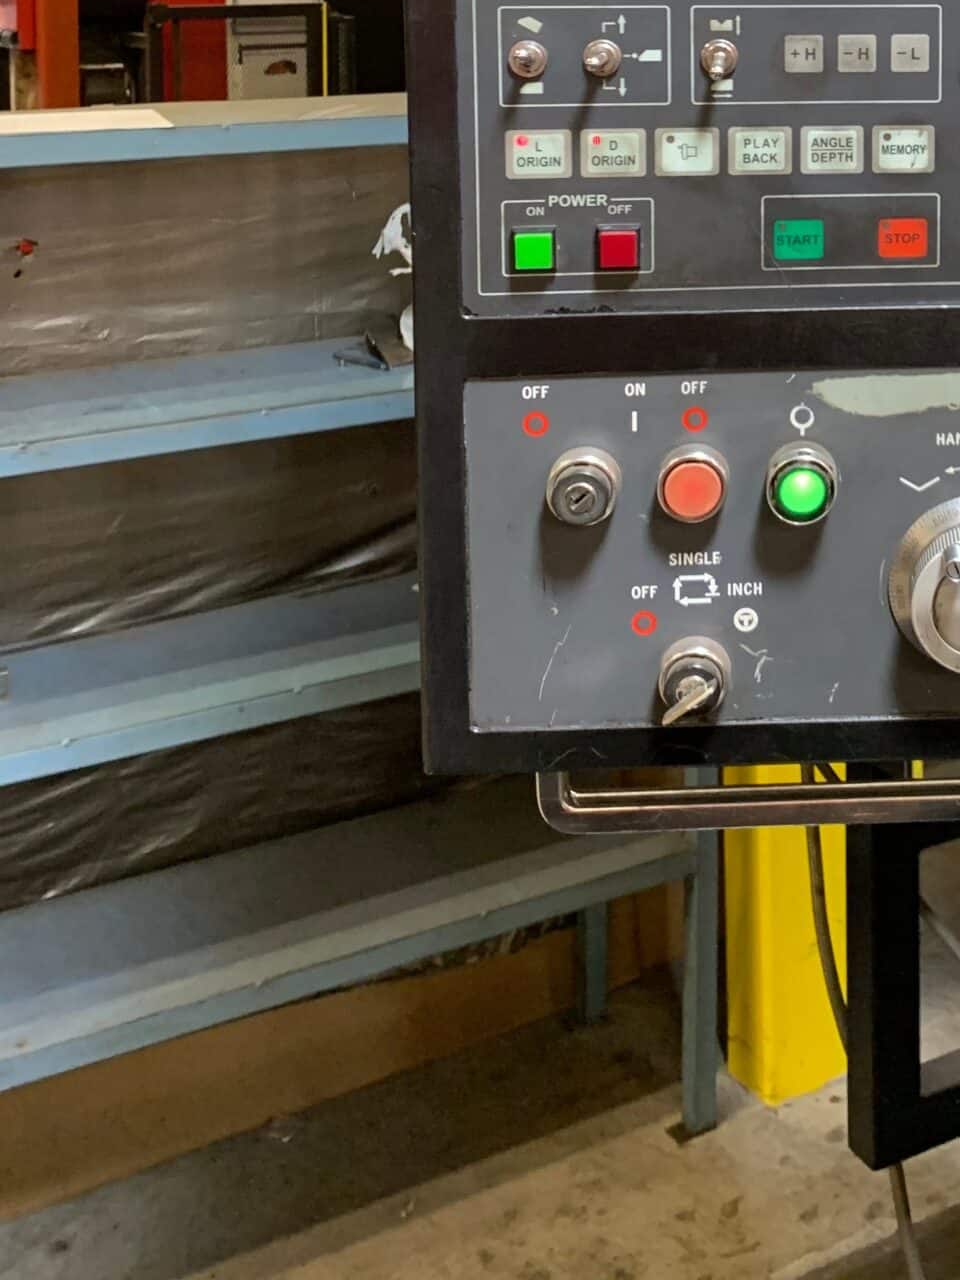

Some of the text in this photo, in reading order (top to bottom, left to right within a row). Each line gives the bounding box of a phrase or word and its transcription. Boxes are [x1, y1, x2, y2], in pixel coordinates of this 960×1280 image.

[535, 141, 542, 152] L
[609, 140, 618, 151] D
[743, 138, 779, 149] PLAY
[811, 137, 853, 148] ANGLE
[881, 144, 927, 155] MEMORY
[516, 156, 561, 168] ORIGIN
[591, 155, 636, 166] ORIGIN
[743, 153, 778, 164] BACK
[811, 152, 853, 163] DEPTH
[548, 194, 608, 207] POWER
[526, 206, 545, 216] ON
[608, 204, 632, 215] OFF
[776, 234, 820, 245] START
[885, 233, 921, 244] STOP
[521, 386, 550, 399] OFF
[624, 382, 646, 396] ON
[681, 381, 708, 394] OFF
[669, 552, 721, 566] SINGLE
[631, 585, 658, 599] OFF
[727, 583, 763, 597] INCH
